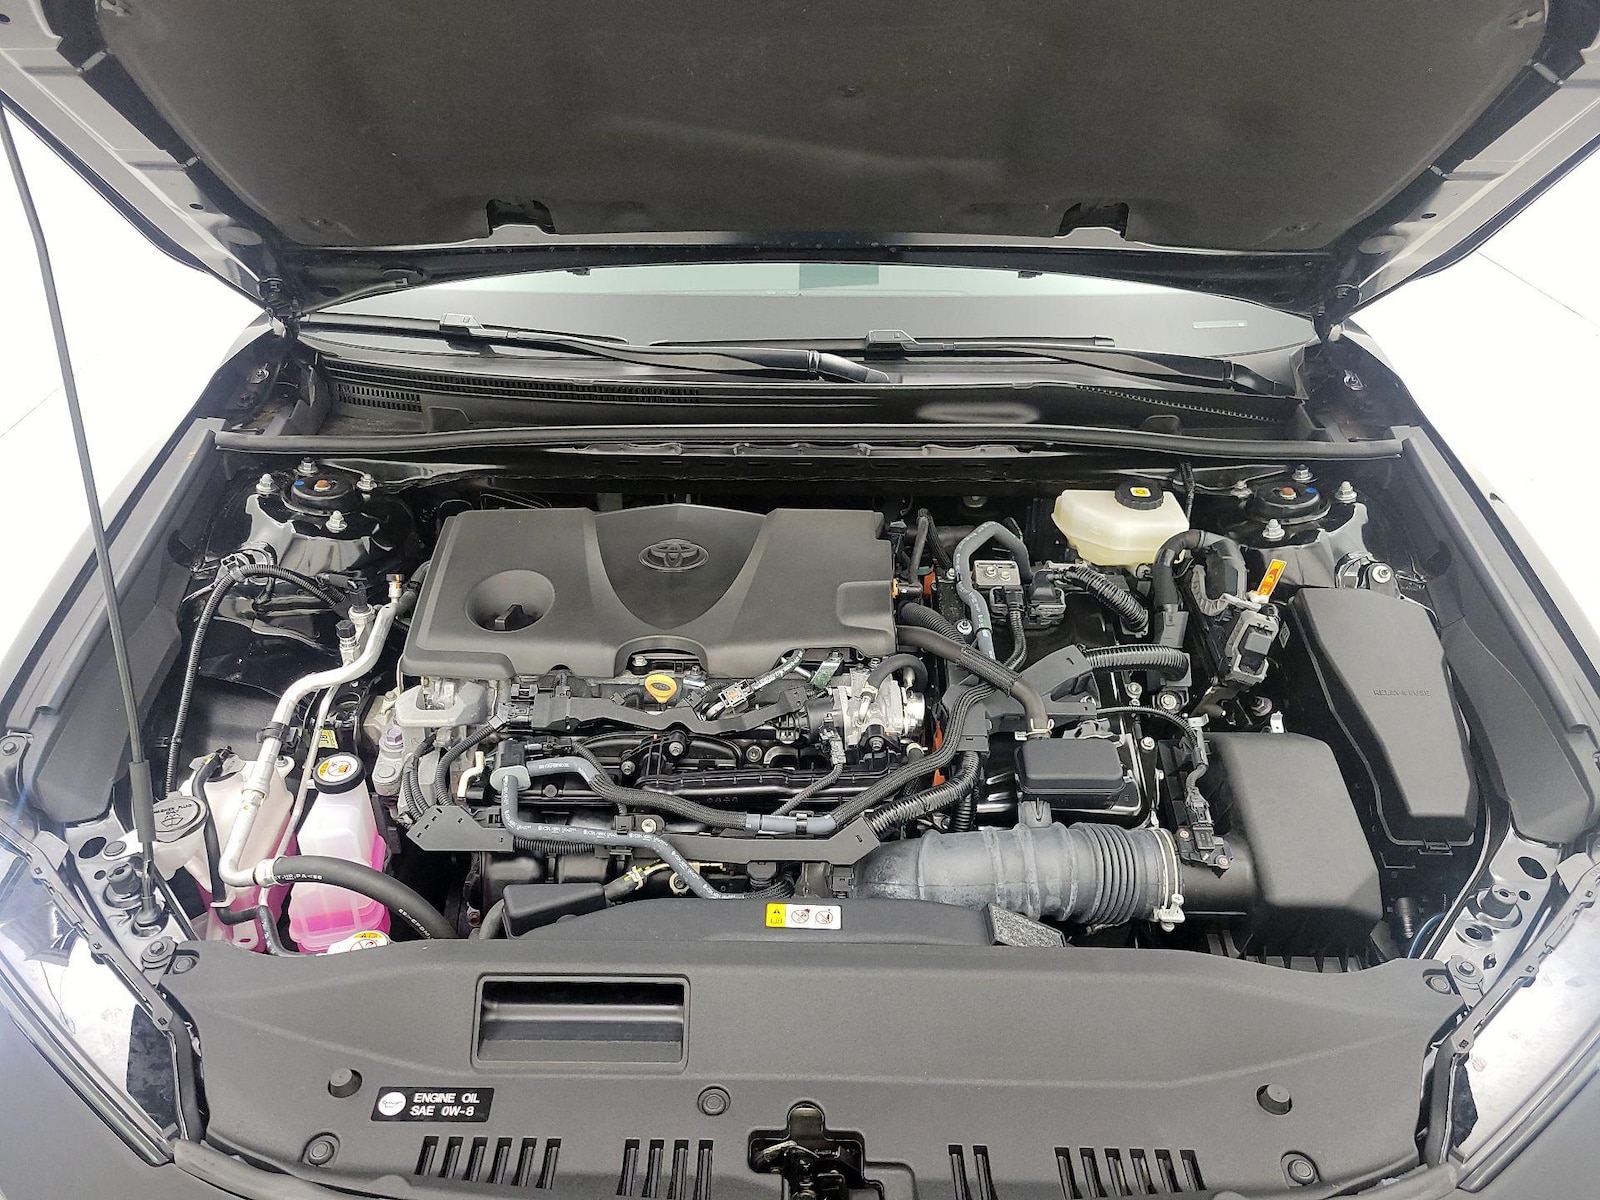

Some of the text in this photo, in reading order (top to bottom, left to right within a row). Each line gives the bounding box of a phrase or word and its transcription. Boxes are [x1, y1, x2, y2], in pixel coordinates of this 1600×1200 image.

[413, 1092, 480, 1104] ENGINE OIL
[410, 1105, 475, 1117] SAE 0W-8
